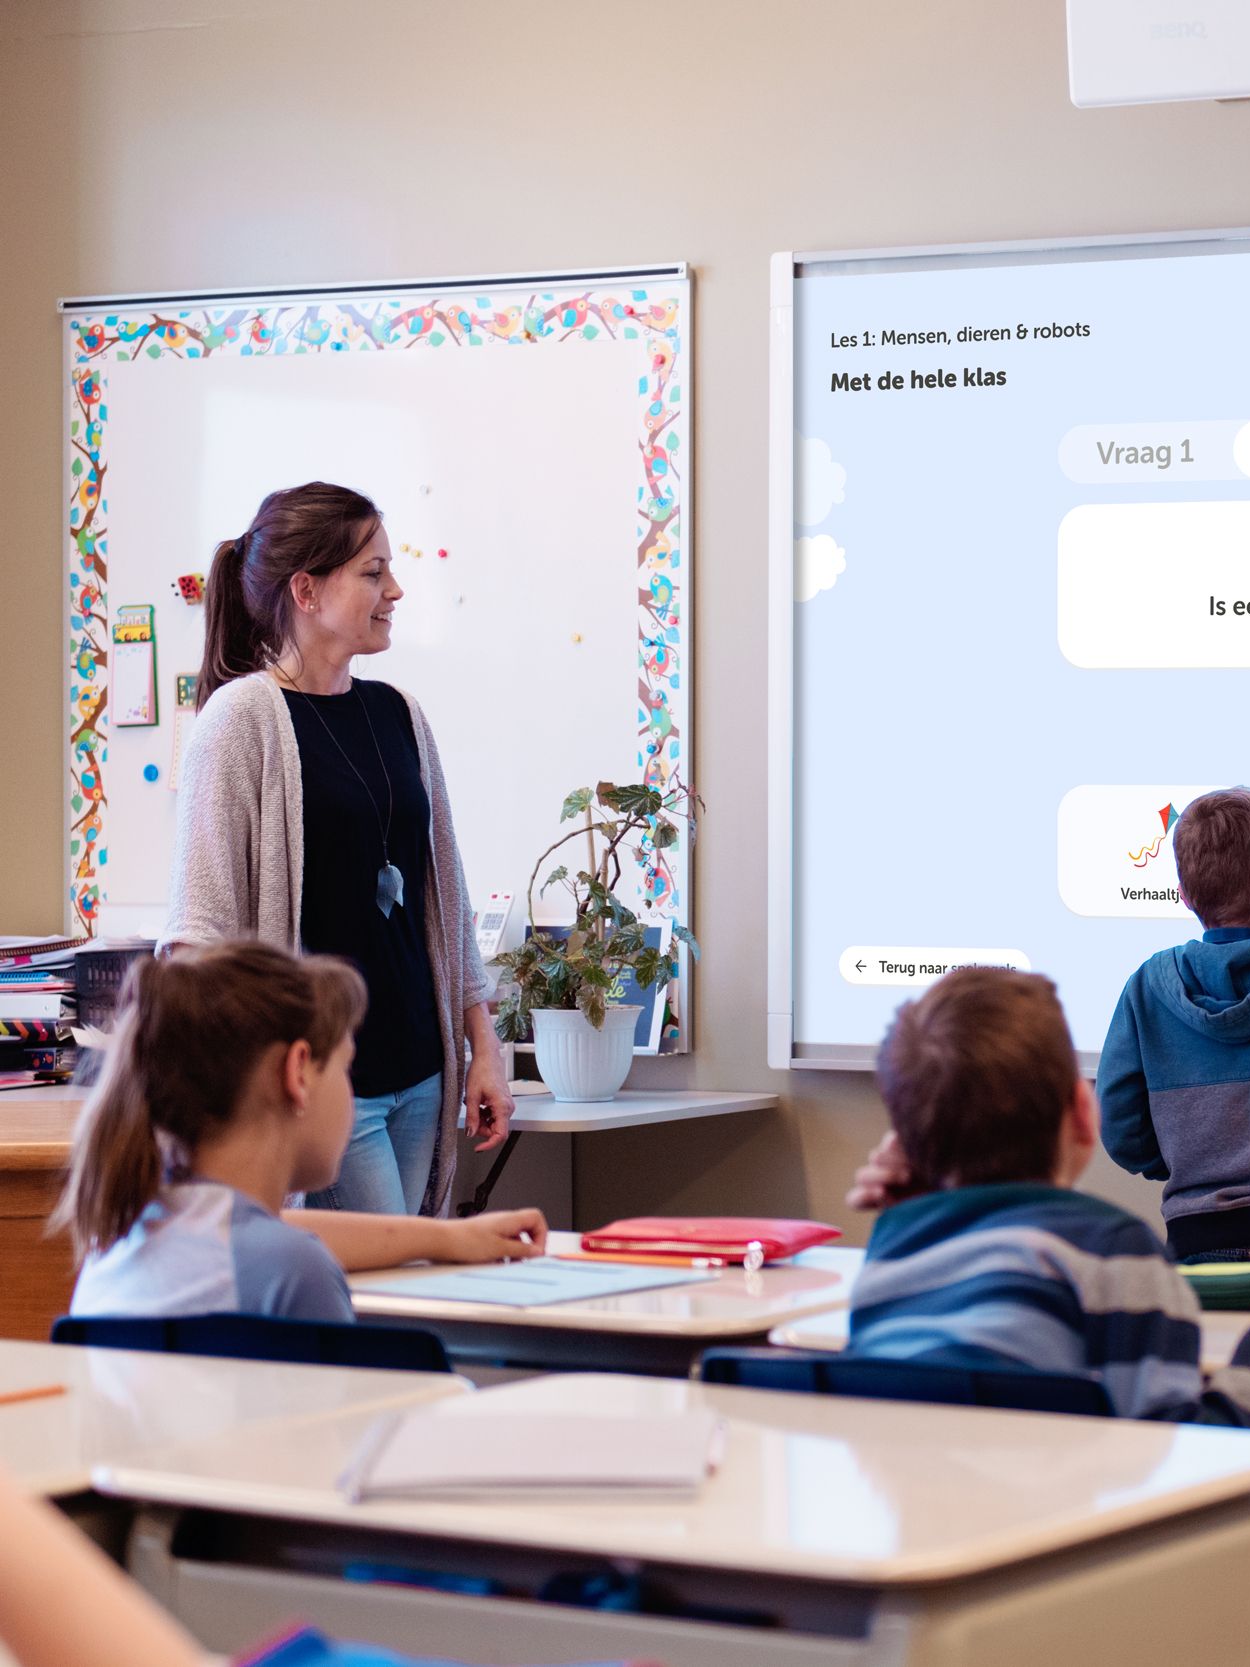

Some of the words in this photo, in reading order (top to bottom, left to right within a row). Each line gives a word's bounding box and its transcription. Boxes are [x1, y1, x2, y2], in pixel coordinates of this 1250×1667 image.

[830, 332, 858, 349] Les
[862, 330, 876, 347] 1:
[880, 328, 952, 347] Mensen,
[956, 325, 1011, 343] dieren
[1015, 323, 1029, 340] &
[1033, 321, 1091, 340] robots
[830, 372, 872, 393] Met
[876, 370, 905, 391] de
[910, 368, 958, 390] hele
[963, 366, 1007, 388] klas
[1096, 441, 1172, 470] Vraag
[1180, 438, 1195, 463] 1
[1209, 595, 1227, 617] Is
[1120, 887, 1184, 904] Verhaaltj
[878, 960, 916, 977] Terug
[918, 963, 948, 975] naar
